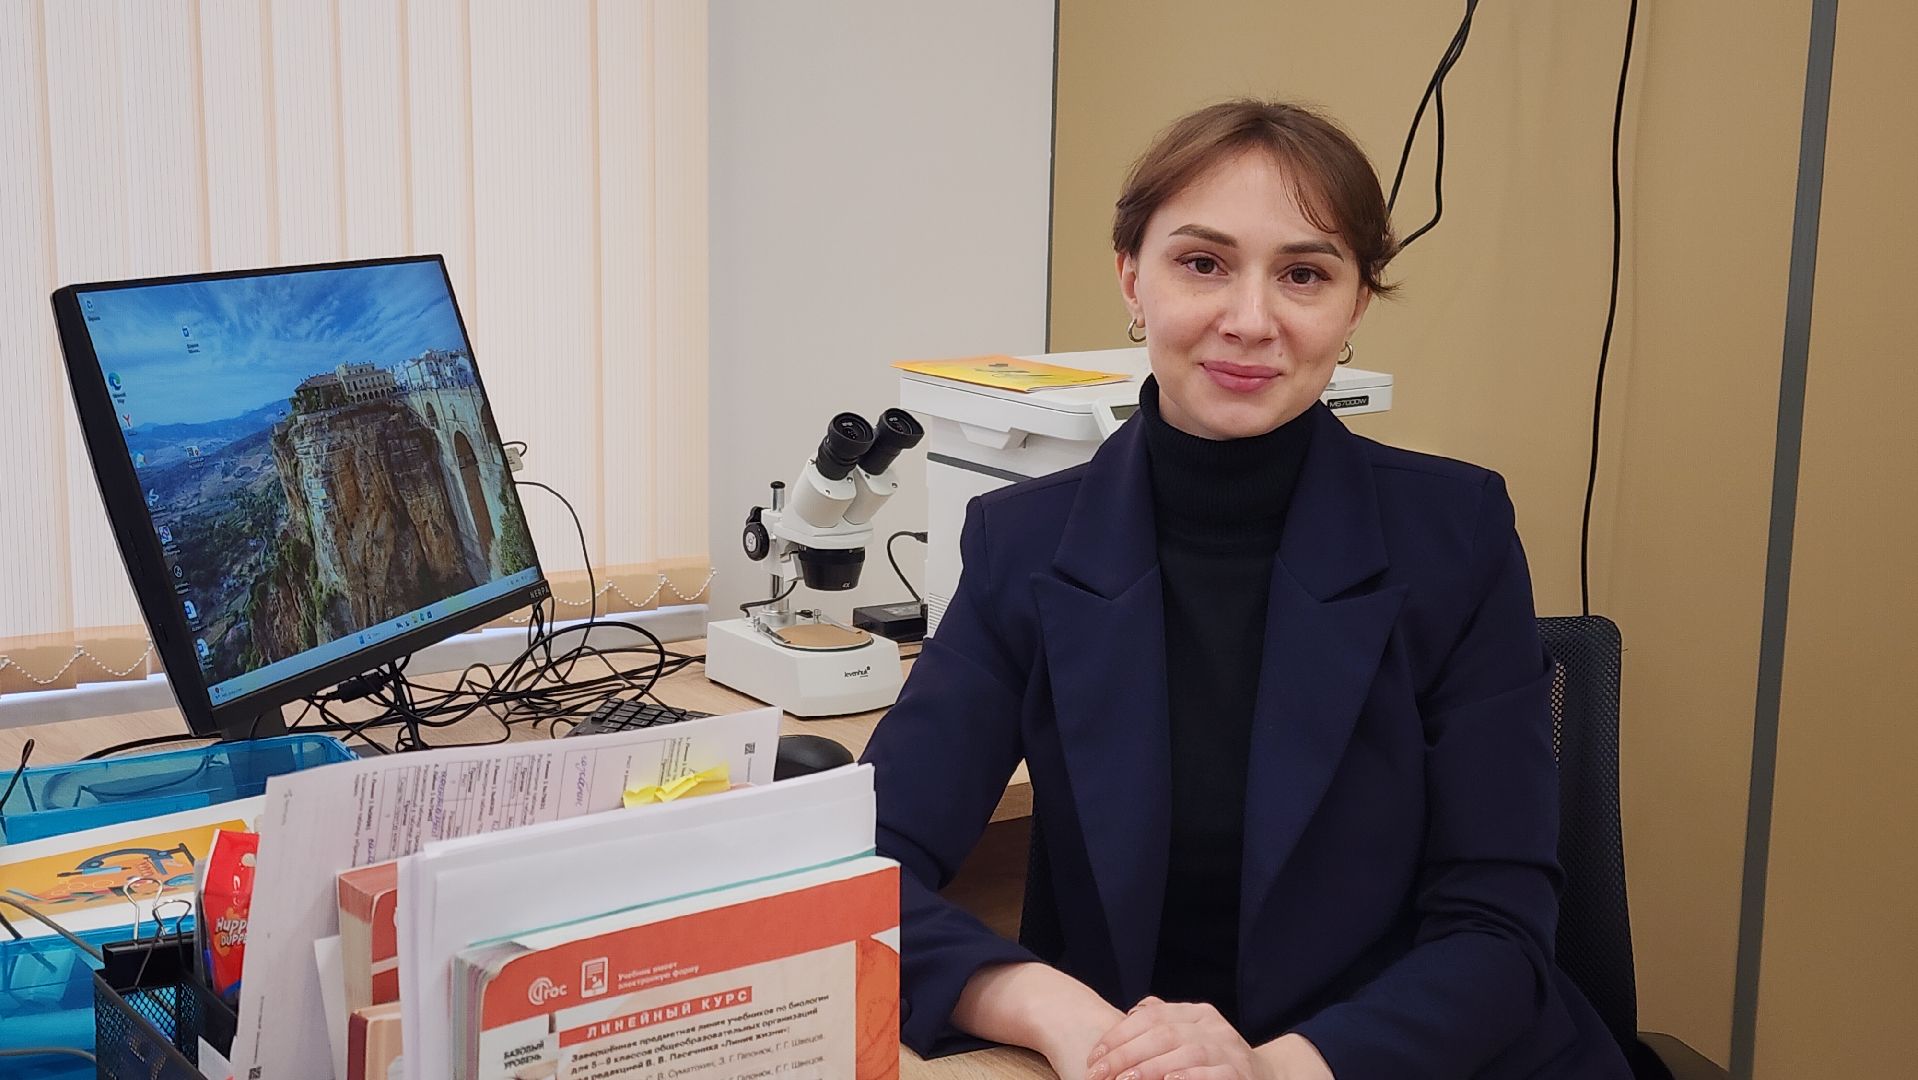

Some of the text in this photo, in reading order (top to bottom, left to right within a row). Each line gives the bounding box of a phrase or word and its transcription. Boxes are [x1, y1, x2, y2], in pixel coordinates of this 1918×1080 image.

[587, 990, 747, 1039] ЛИНЕЙНЫЙ КУРС
[614, 1049, 652, 1063] классов
[654, 1023, 760, 1054] общеобразовательных
[762, 1008, 818, 1027] организаций
[639, 1027, 696, 1046] предметная
[698, 1019, 725, 1031] линия
[727, 1008, 774, 1025] учебников
[776, 1005, 787, 1013] по
[788, 995, 829, 1010] биологии
[504, 1040, 544, 1059] БАЗОВЫЙ
[504, 1054, 542, 1070] УРОВЕНЬ
[591, 1061, 643, 1080] редакцией
[670, 1043, 719, 1060] Пасечника
